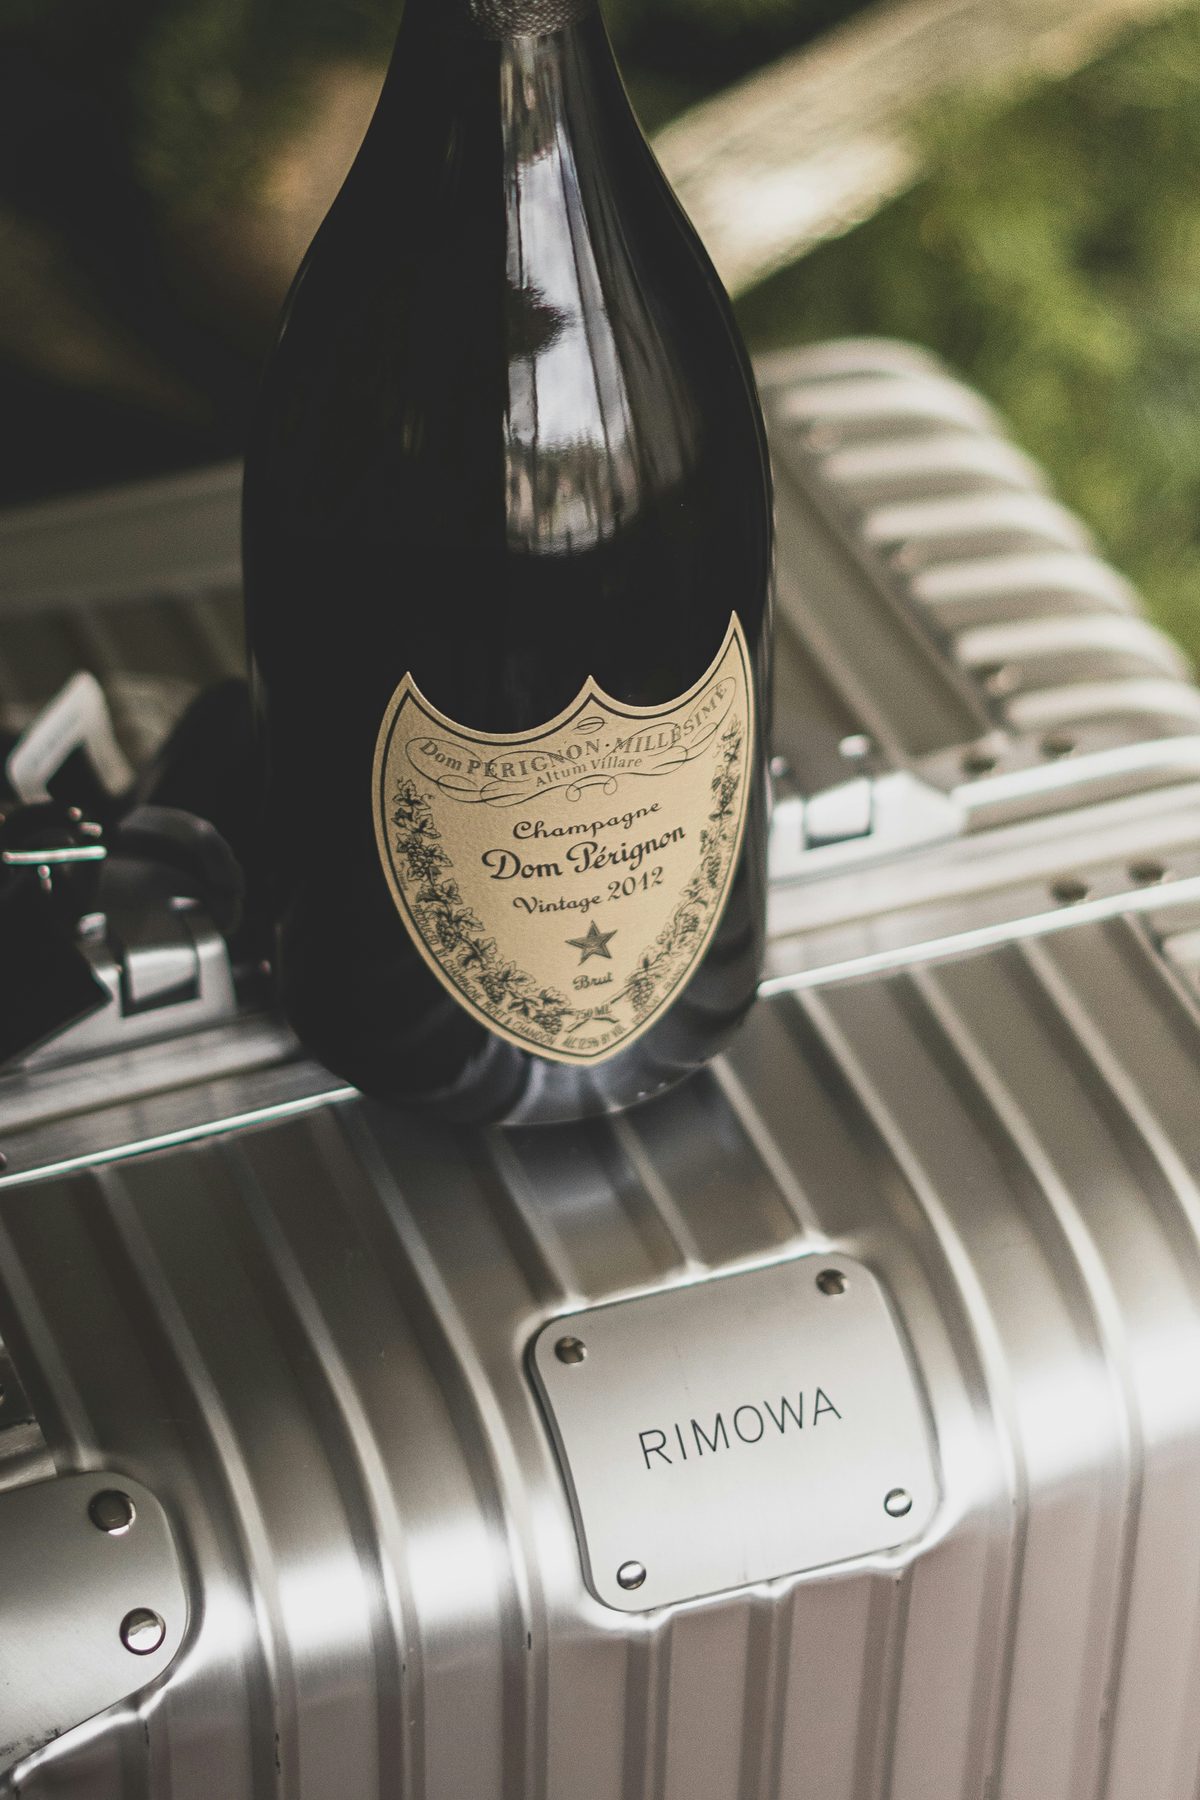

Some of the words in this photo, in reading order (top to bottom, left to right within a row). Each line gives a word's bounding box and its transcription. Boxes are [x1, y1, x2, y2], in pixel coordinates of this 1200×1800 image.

[419, 740, 462, 772] Dom
[535, 763, 588, 788] Altum
[591, 756, 643, 771] Villare
[512, 802, 662, 839] Champagne
[481, 848, 563, 880] Dom
[565, 826, 686, 873] Pérignon
[512, 895, 601, 914] Vintage
[607, 866, 664, 902] 2012
[572, 971, 614, 990] Brut
[638, 1386, 842, 1470] RIMOWA
